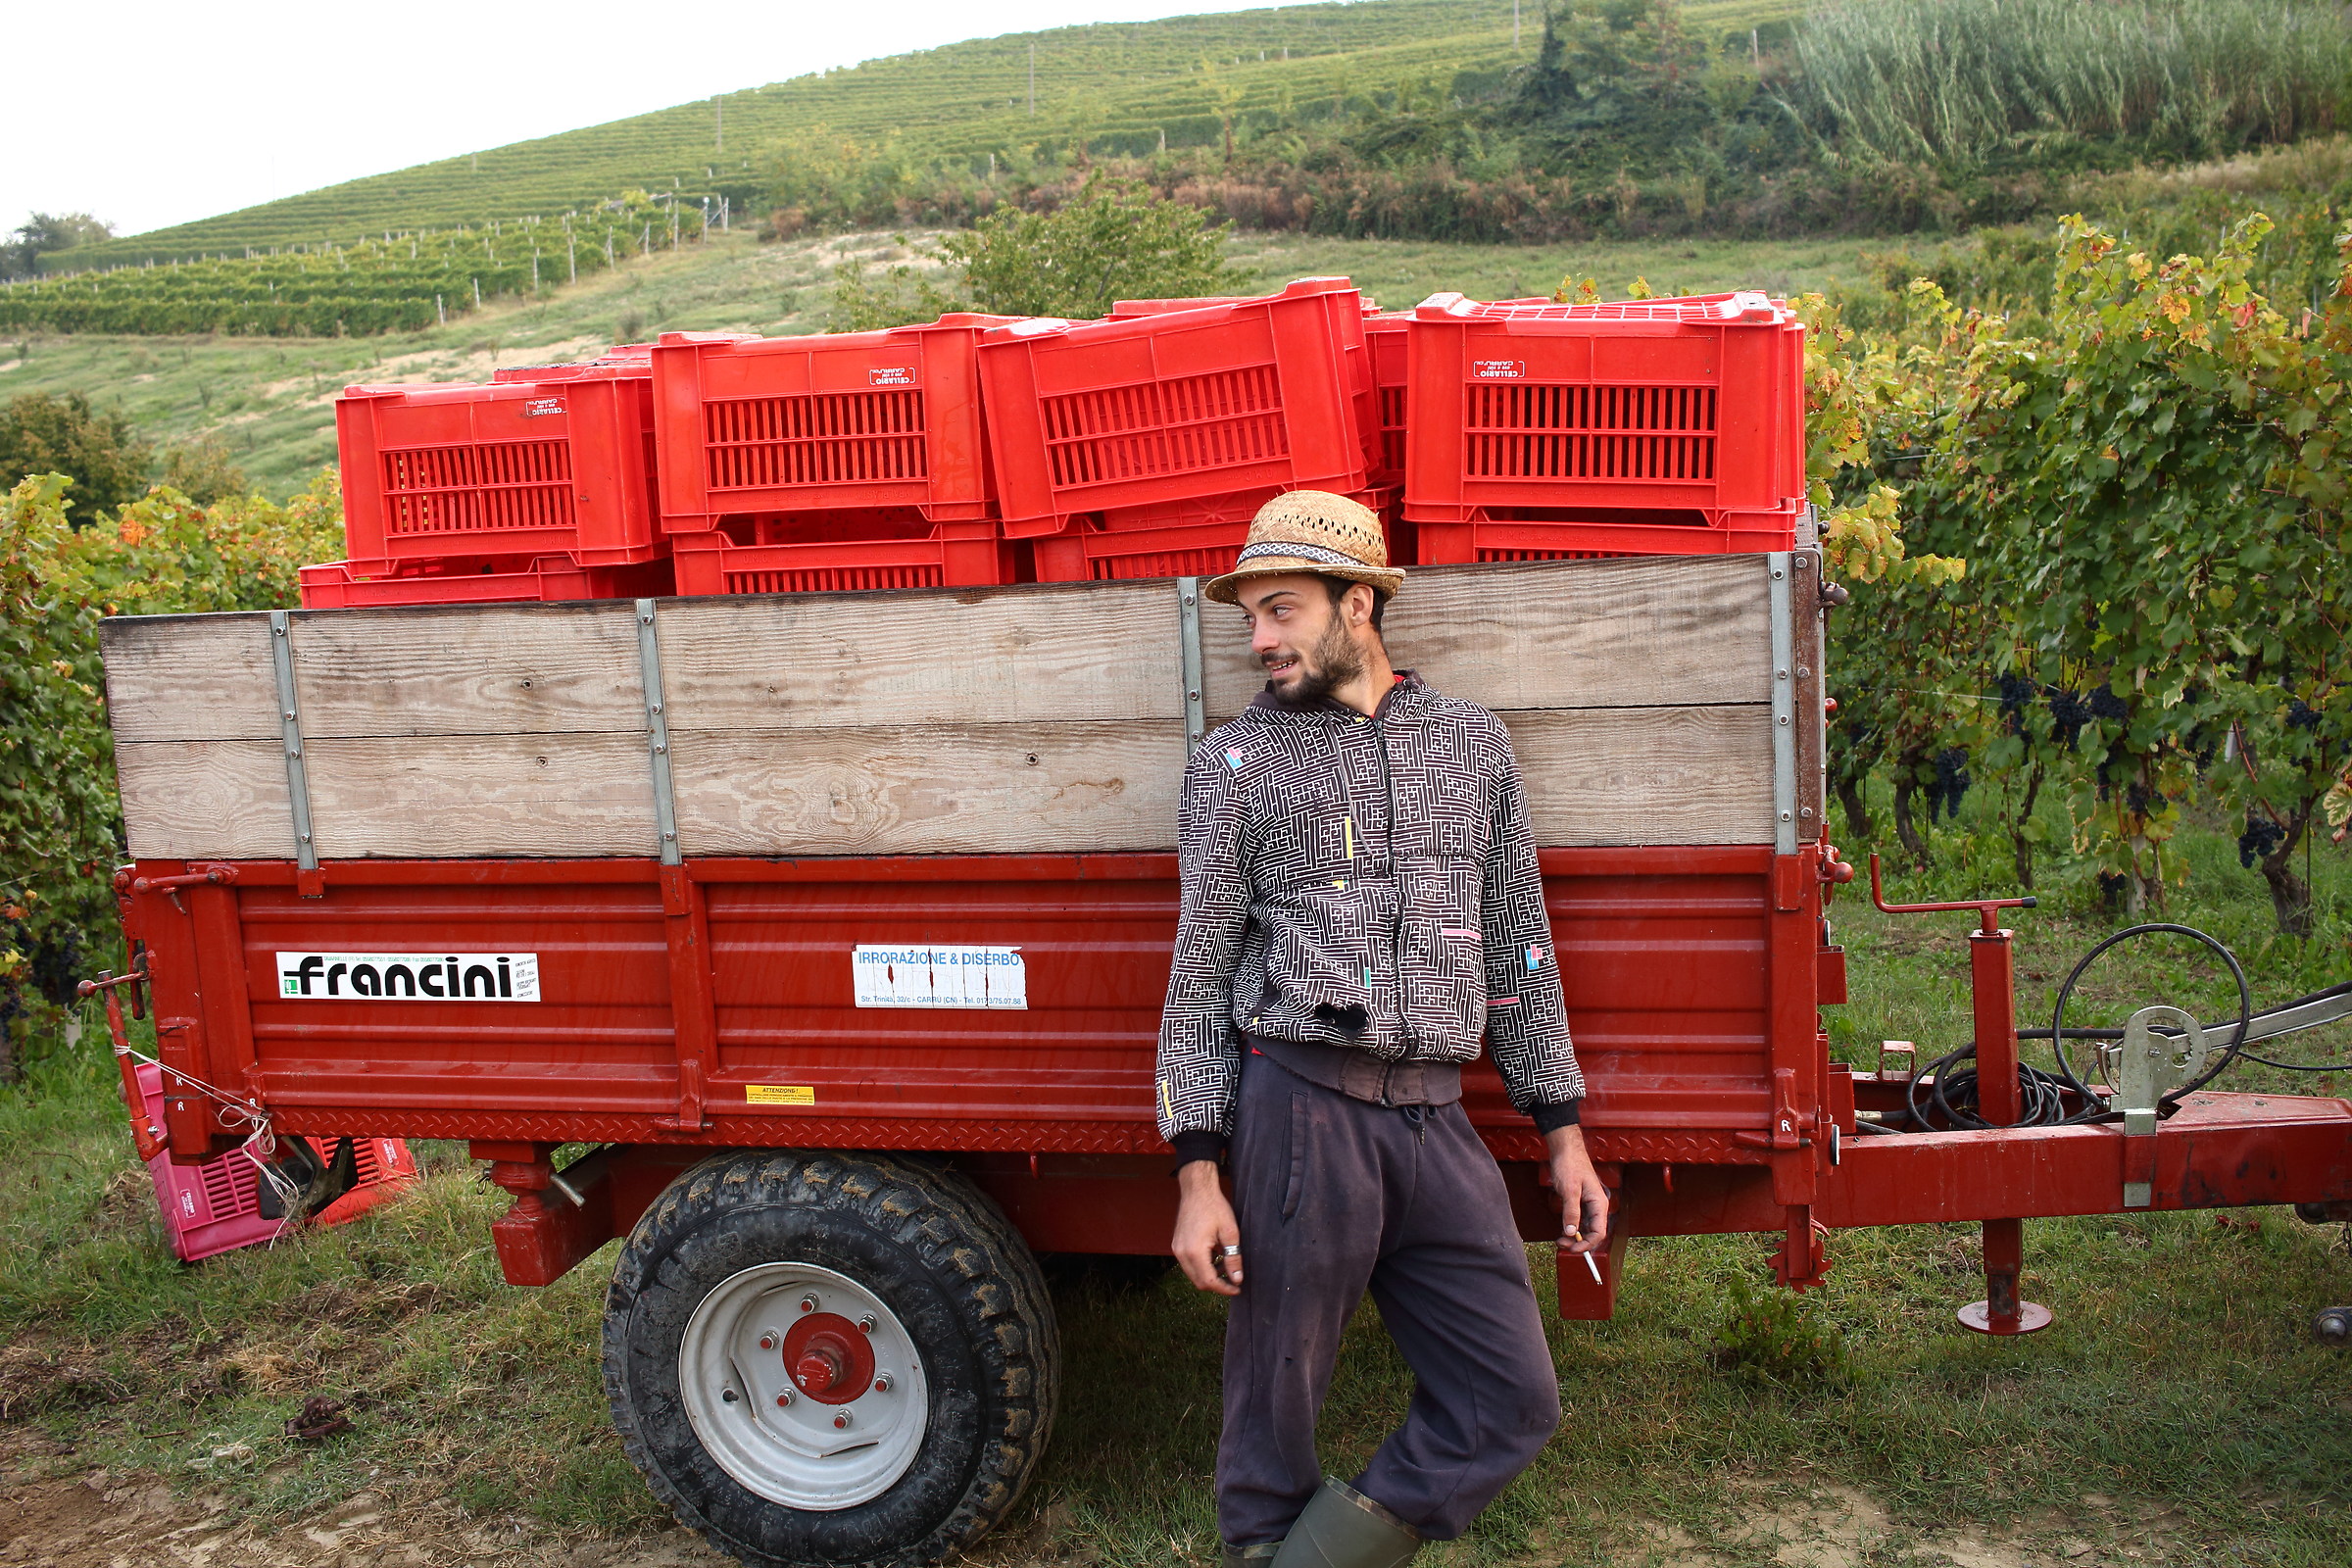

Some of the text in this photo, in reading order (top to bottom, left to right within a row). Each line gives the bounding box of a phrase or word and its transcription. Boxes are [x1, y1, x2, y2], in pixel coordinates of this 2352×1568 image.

[875, 376, 910, 385] CELLARIO
[531, 407, 563, 416] CELLARIO
[858, 952, 1019, 966] IRRORAZIONE & DISERBO
[284, 956, 513, 998] francini
[943, 996, 958, 1004] (CN)
[963, 996, 975, 1004] Tel.
[976, 997, 1021, 1005] 0173/75.07.88
[177, 1101, 184, 1111] R
[1781, 1119, 1791, 1132] R
